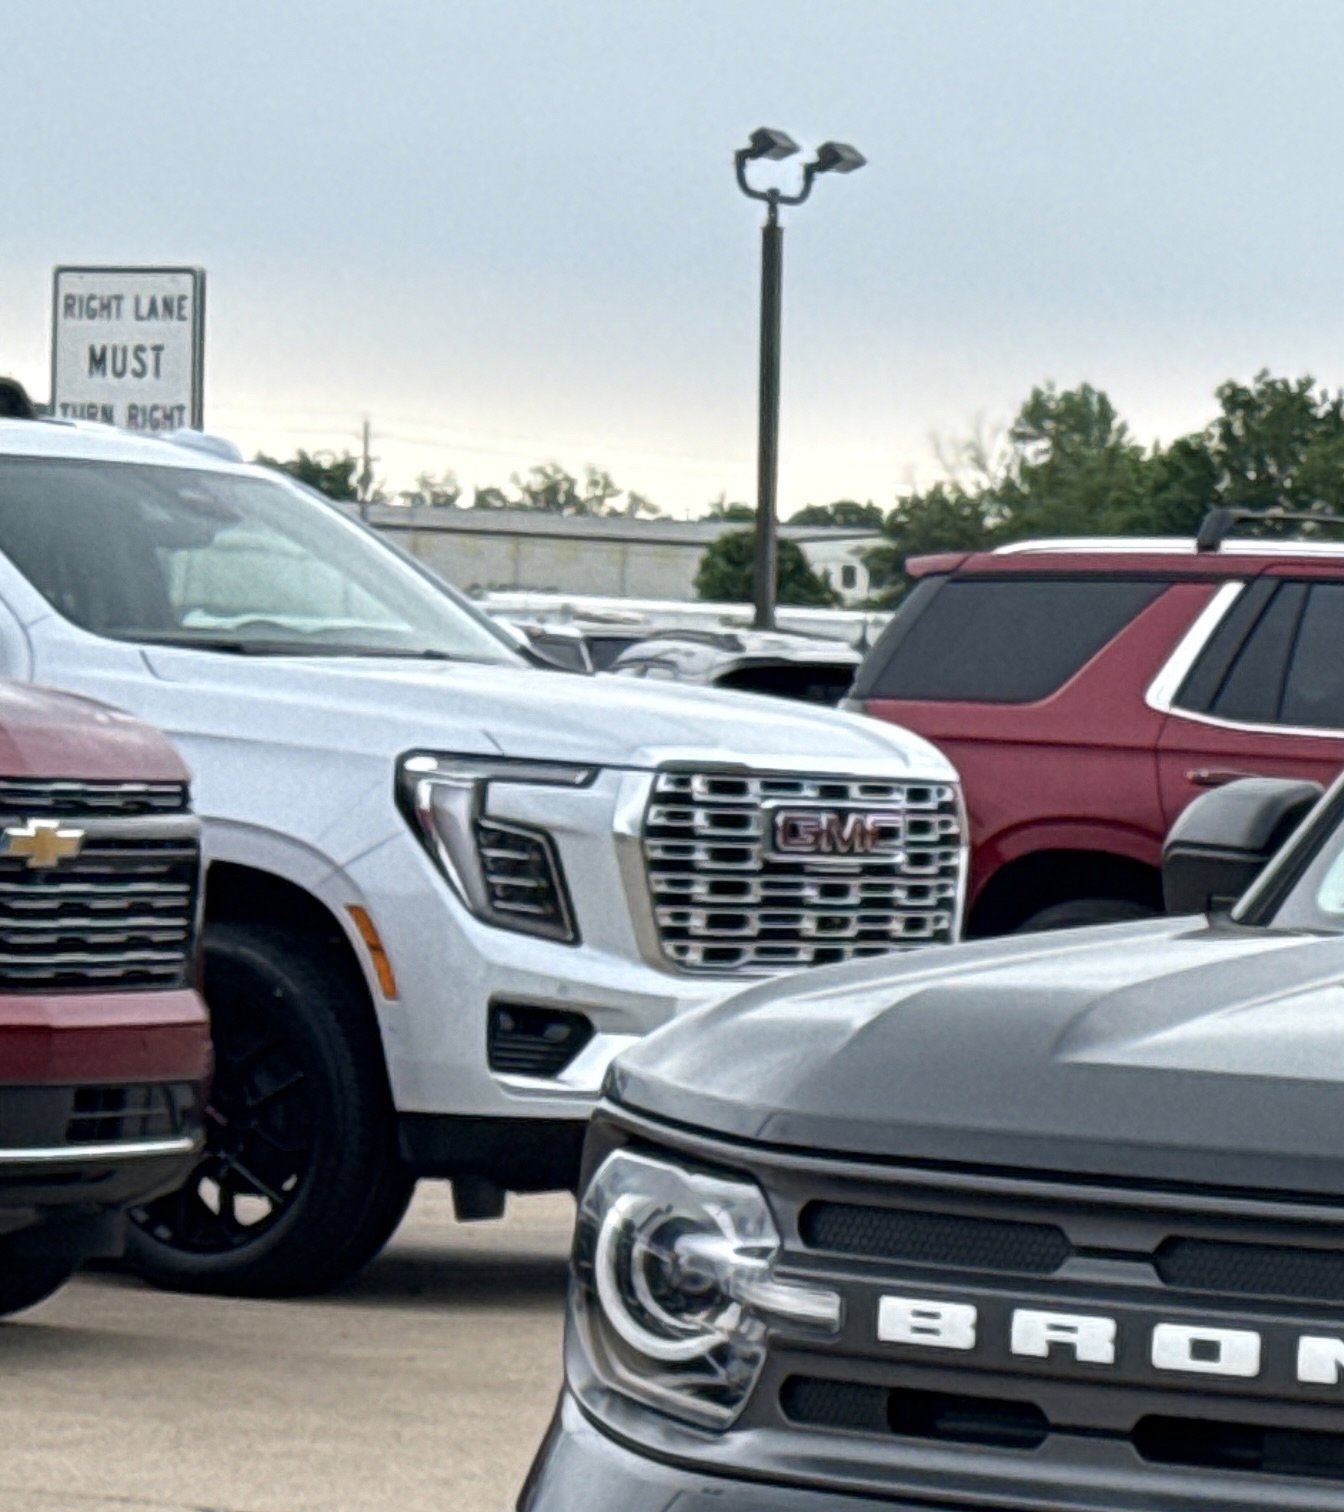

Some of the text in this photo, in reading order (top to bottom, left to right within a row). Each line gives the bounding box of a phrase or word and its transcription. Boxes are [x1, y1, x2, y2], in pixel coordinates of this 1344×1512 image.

[63, 294, 188, 321] RIGHT LANE
[88, 344, 164, 379] MUST
[127, 402, 187, 430] RIGHT
[774, 810, 903, 853] GMC
